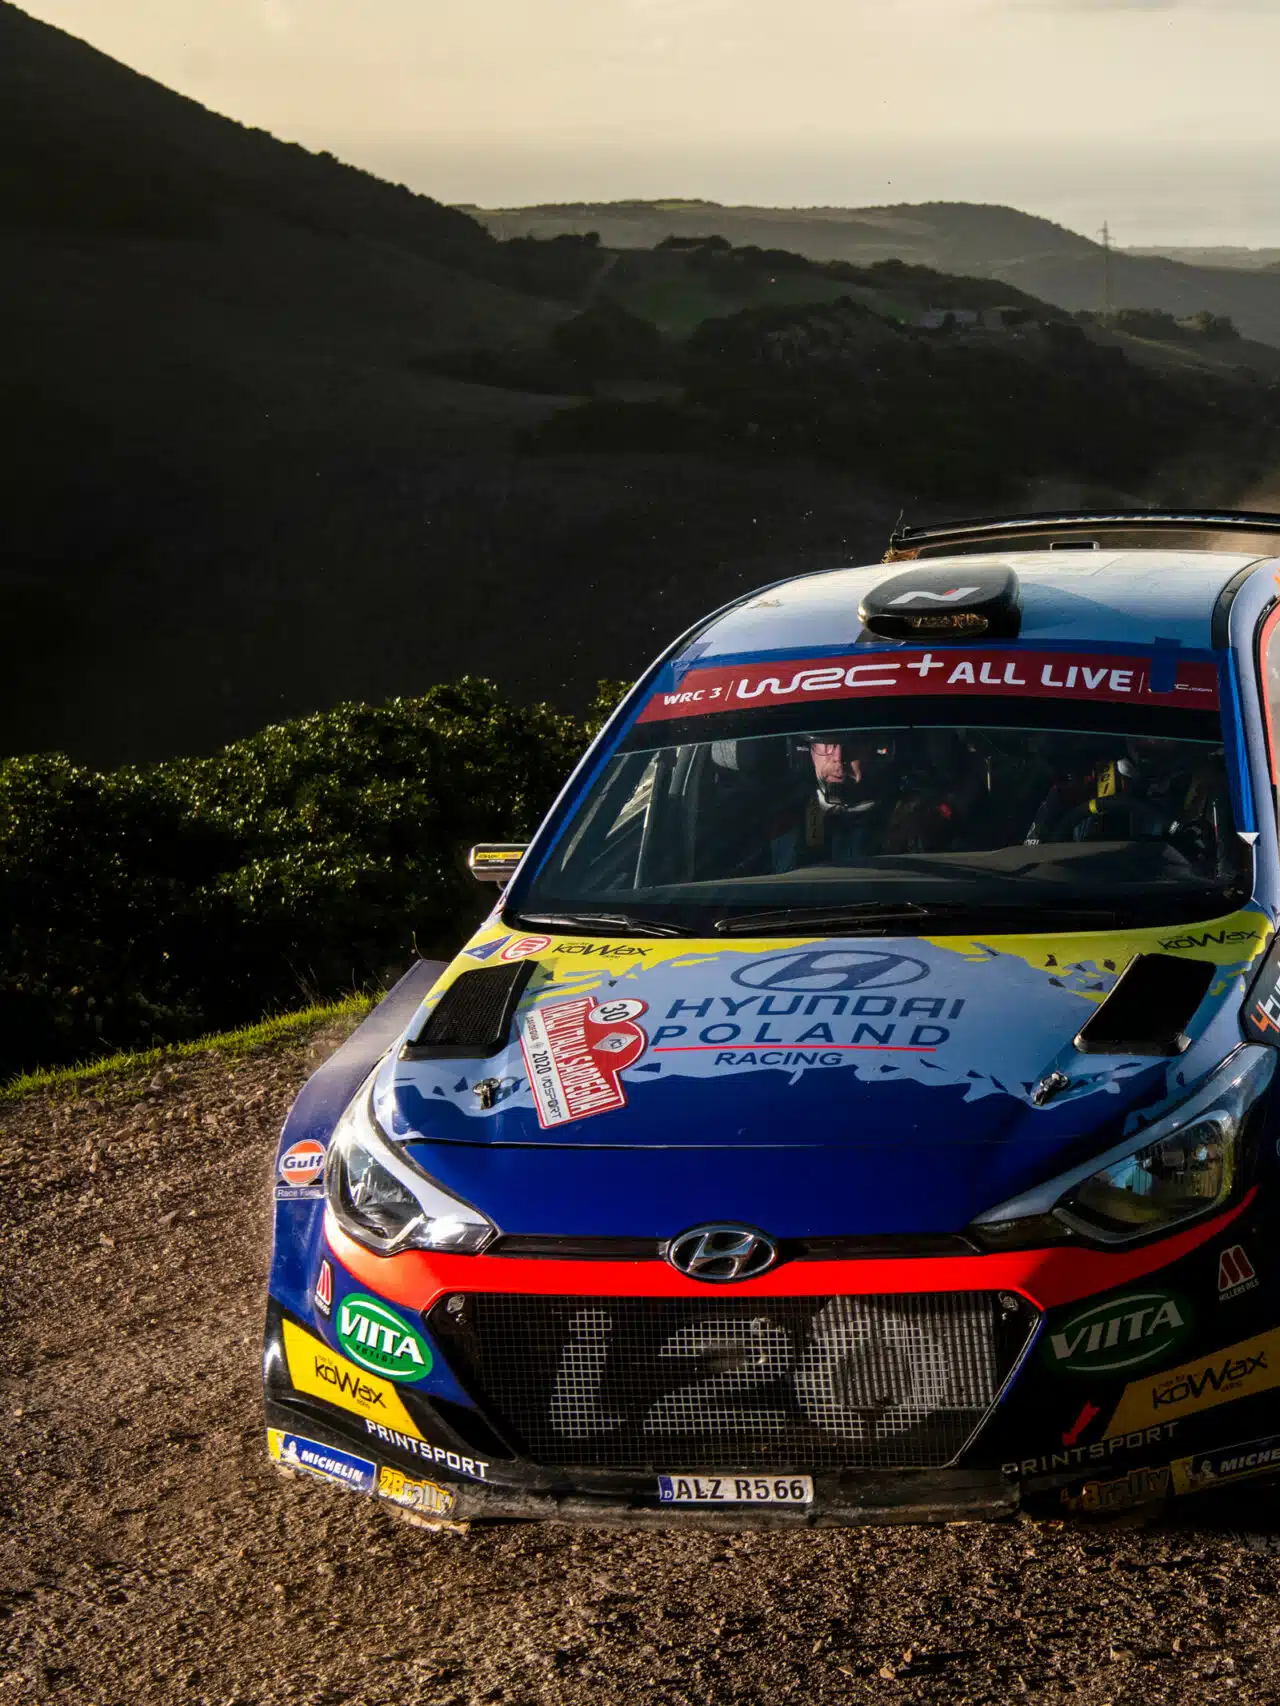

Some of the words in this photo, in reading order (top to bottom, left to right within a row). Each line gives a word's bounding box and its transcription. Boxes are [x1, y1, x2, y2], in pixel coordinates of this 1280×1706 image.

[947, 661, 1026, 685] ALL
[1041, 664, 1134, 692] LIVE
[663, 689, 705, 705] WRC
[708, 687, 723, 699] 3
[542, 1000, 588, 1031] RALLY
[600, 1003, 629, 1021] 30
[665, 995, 966, 1019] HYUNDAI
[548, 1028, 589, 1060] ITALIA
[650, 1022, 951, 1046] POLAND
[532, 1050, 551, 1074] 2020
[714, 1052, 844, 1066] RACING
[557, 1055, 620, 1114] SARDEGNA
[283, 1154, 324, 1170] Gulf
[341, 1306, 425, 1365] VIITA
[1050, 1300, 1184, 1360] VIITA
[365, 1418, 489, 1478] PRINTSPORT
[1001, 1421, 1181, 1476] PRINTSPORT
[300, 1450, 364, 1482] MICHELIN
[664, 1490, 672, 1498] D
[675, 1479, 724, 1499] ALZ
[735, 1479, 804, 1499] R566
